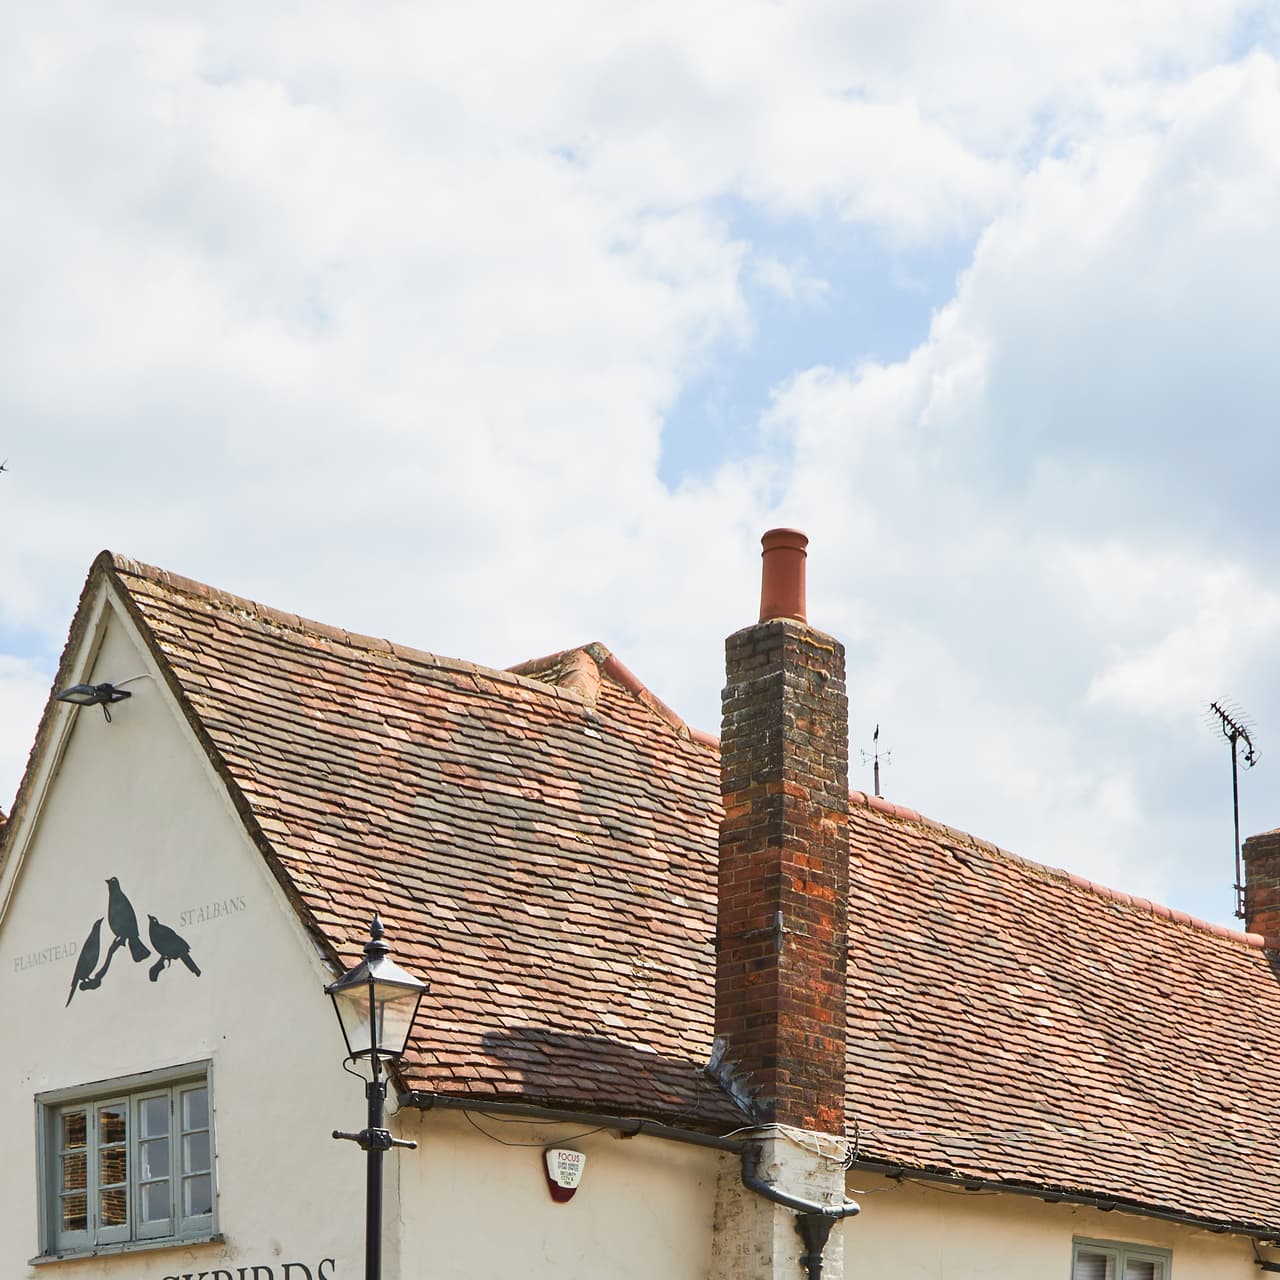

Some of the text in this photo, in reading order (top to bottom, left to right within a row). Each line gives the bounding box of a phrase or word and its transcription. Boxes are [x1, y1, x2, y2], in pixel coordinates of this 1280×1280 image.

[13, 896, 247, 973] FLAMSTEAD ST ALBANS
[558, 1152, 580, 1163] FOCUS
